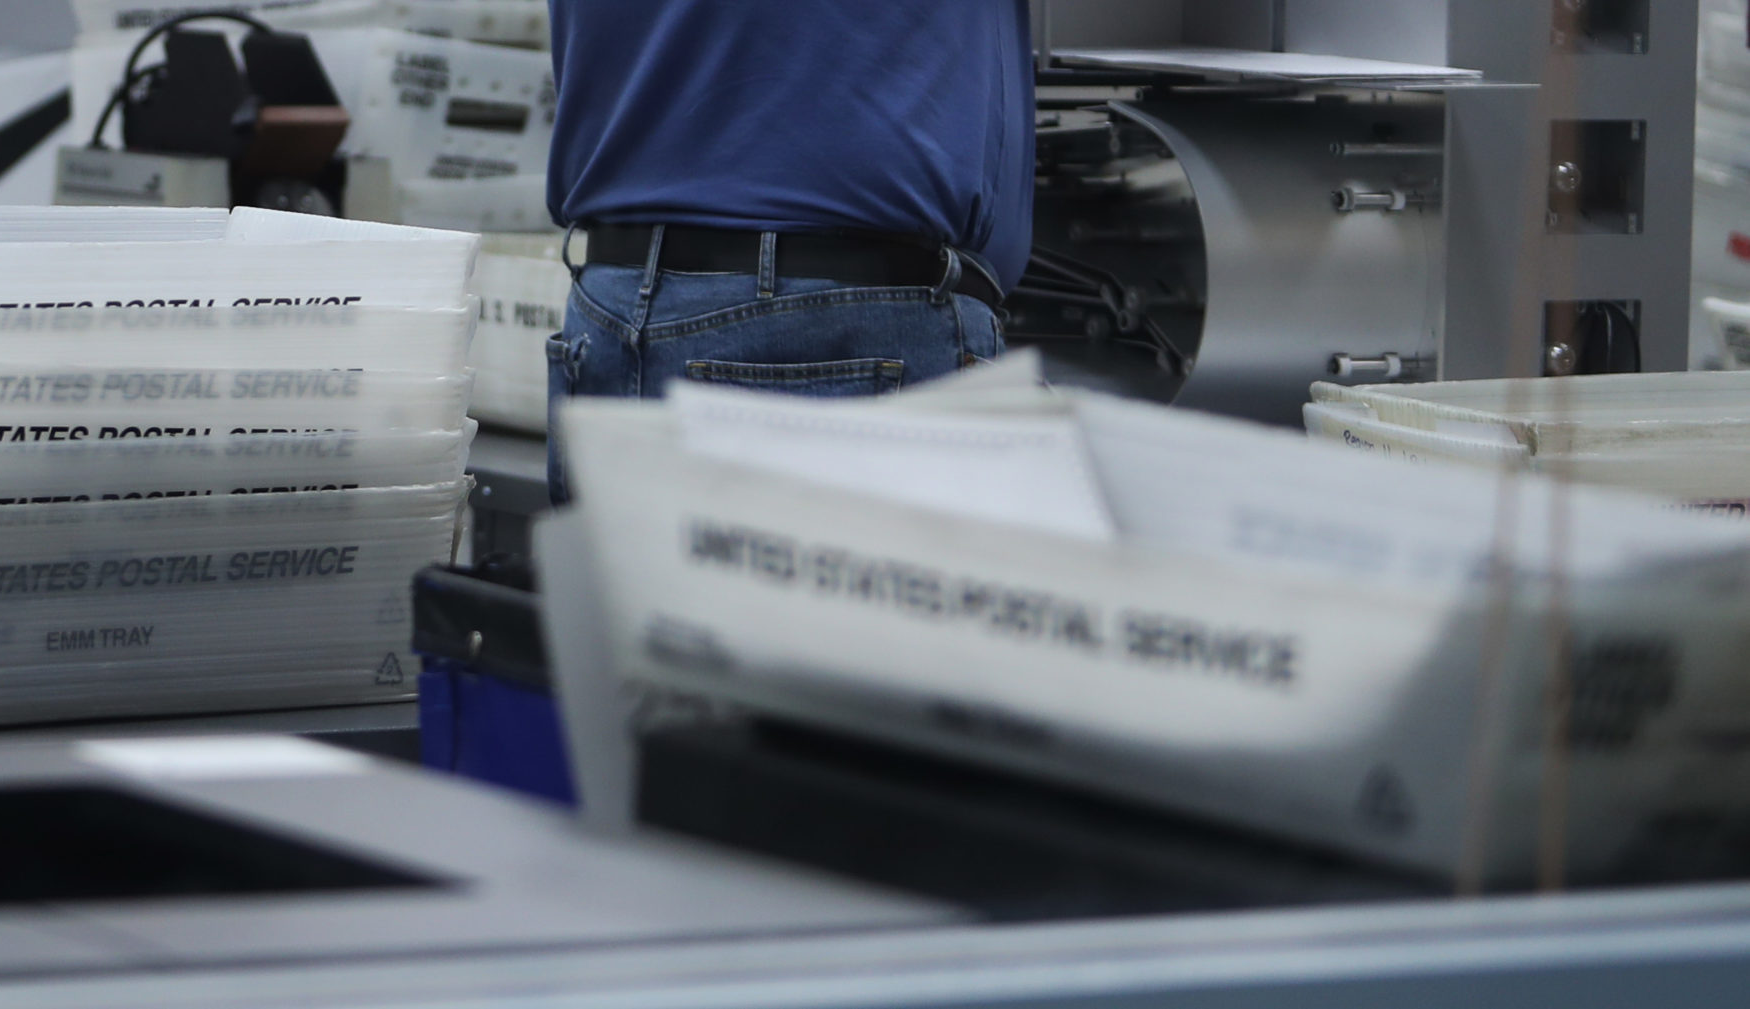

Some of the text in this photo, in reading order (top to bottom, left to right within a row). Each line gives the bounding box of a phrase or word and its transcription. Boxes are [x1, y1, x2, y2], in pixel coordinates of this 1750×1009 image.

[99, 372, 221, 401] POSTAL
[230, 368, 363, 398] SERVICE
[98, 554, 217, 588] POSTAL
[227, 545, 359, 581] SERVICE
[686, 518, 799, 583] UNITED
[1116, 609, 1302, 685] SERVICE
[47, 625, 155, 652] EMM TRAY
